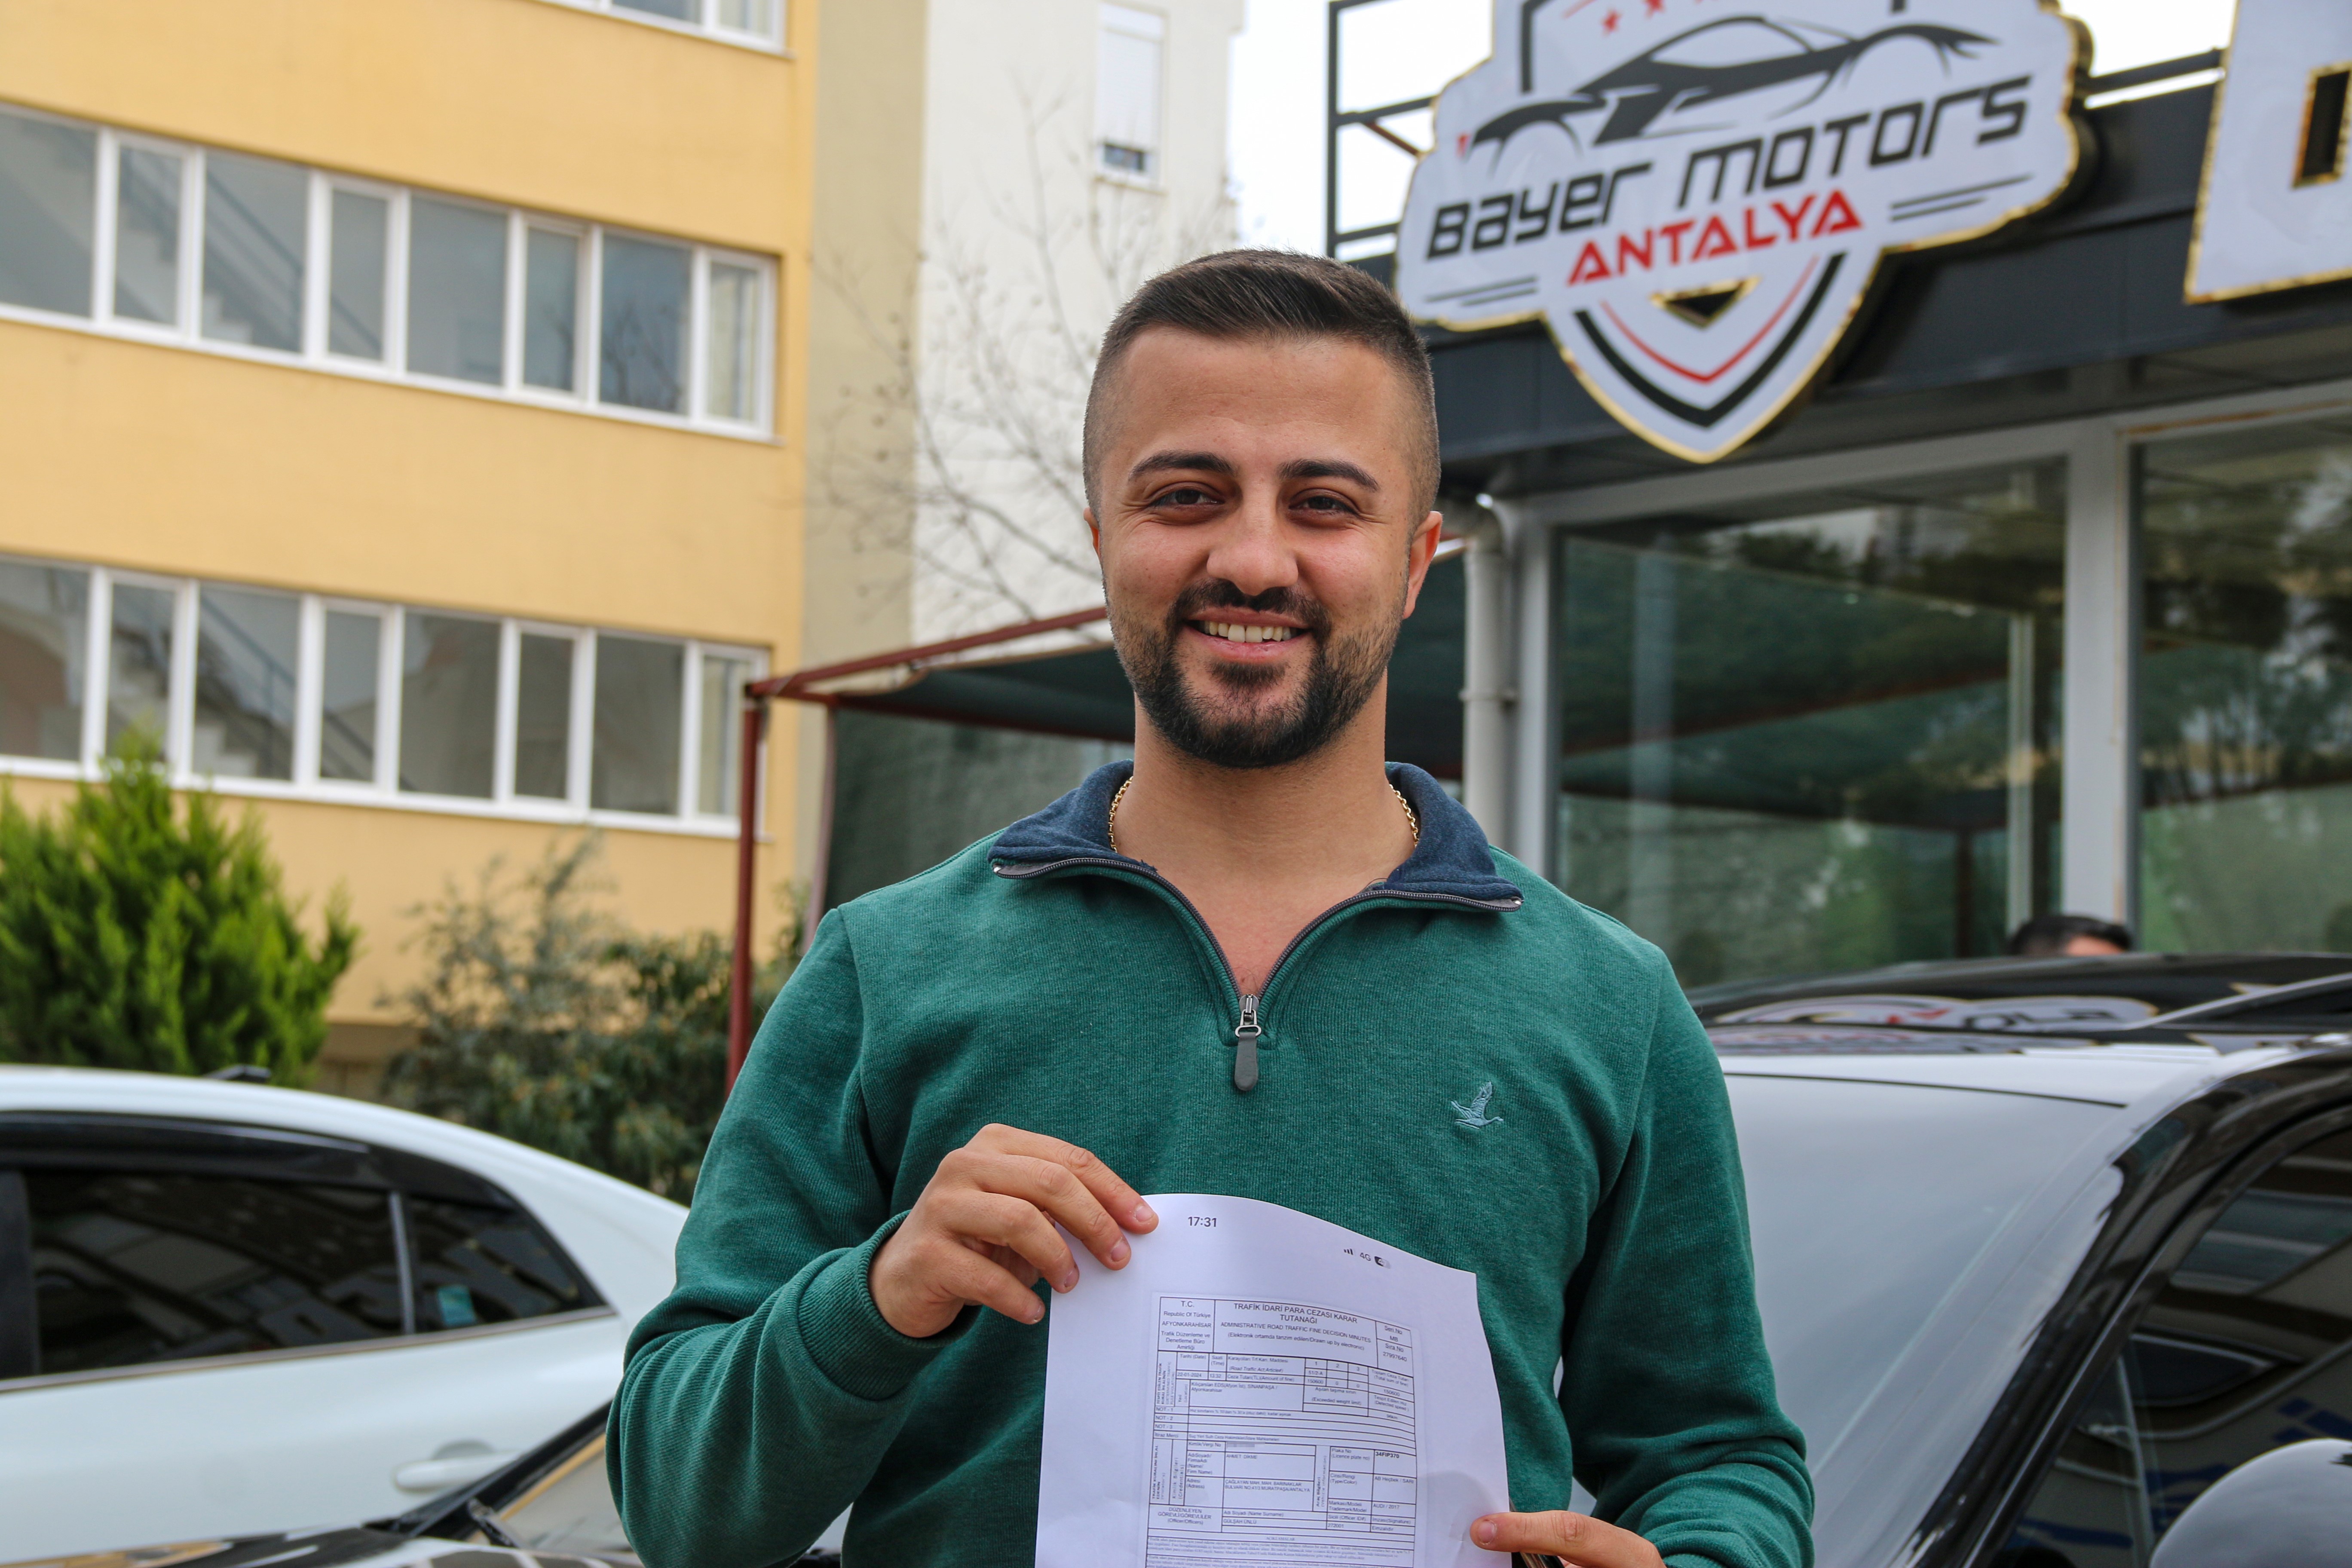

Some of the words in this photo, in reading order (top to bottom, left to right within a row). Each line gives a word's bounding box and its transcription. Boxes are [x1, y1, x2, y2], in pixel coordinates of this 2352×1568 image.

[1567, 188, 1865, 286] ANTALYA
[1188, 1216, 1217, 1227] 17:31
[1360, 1252, 1371, 1262] 4G
[1262, 1304, 1283, 1312] İDARİ
[1307, 1309, 1332, 1318] CEZASI
[1334, 1314, 1357, 1323] KARAR
[1280, 1314, 1317, 1324] TUTANAĞI
[1323, 1329, 1348, 1338] DECISION
[1349, 1334, 1371, 1343] MINUTES
